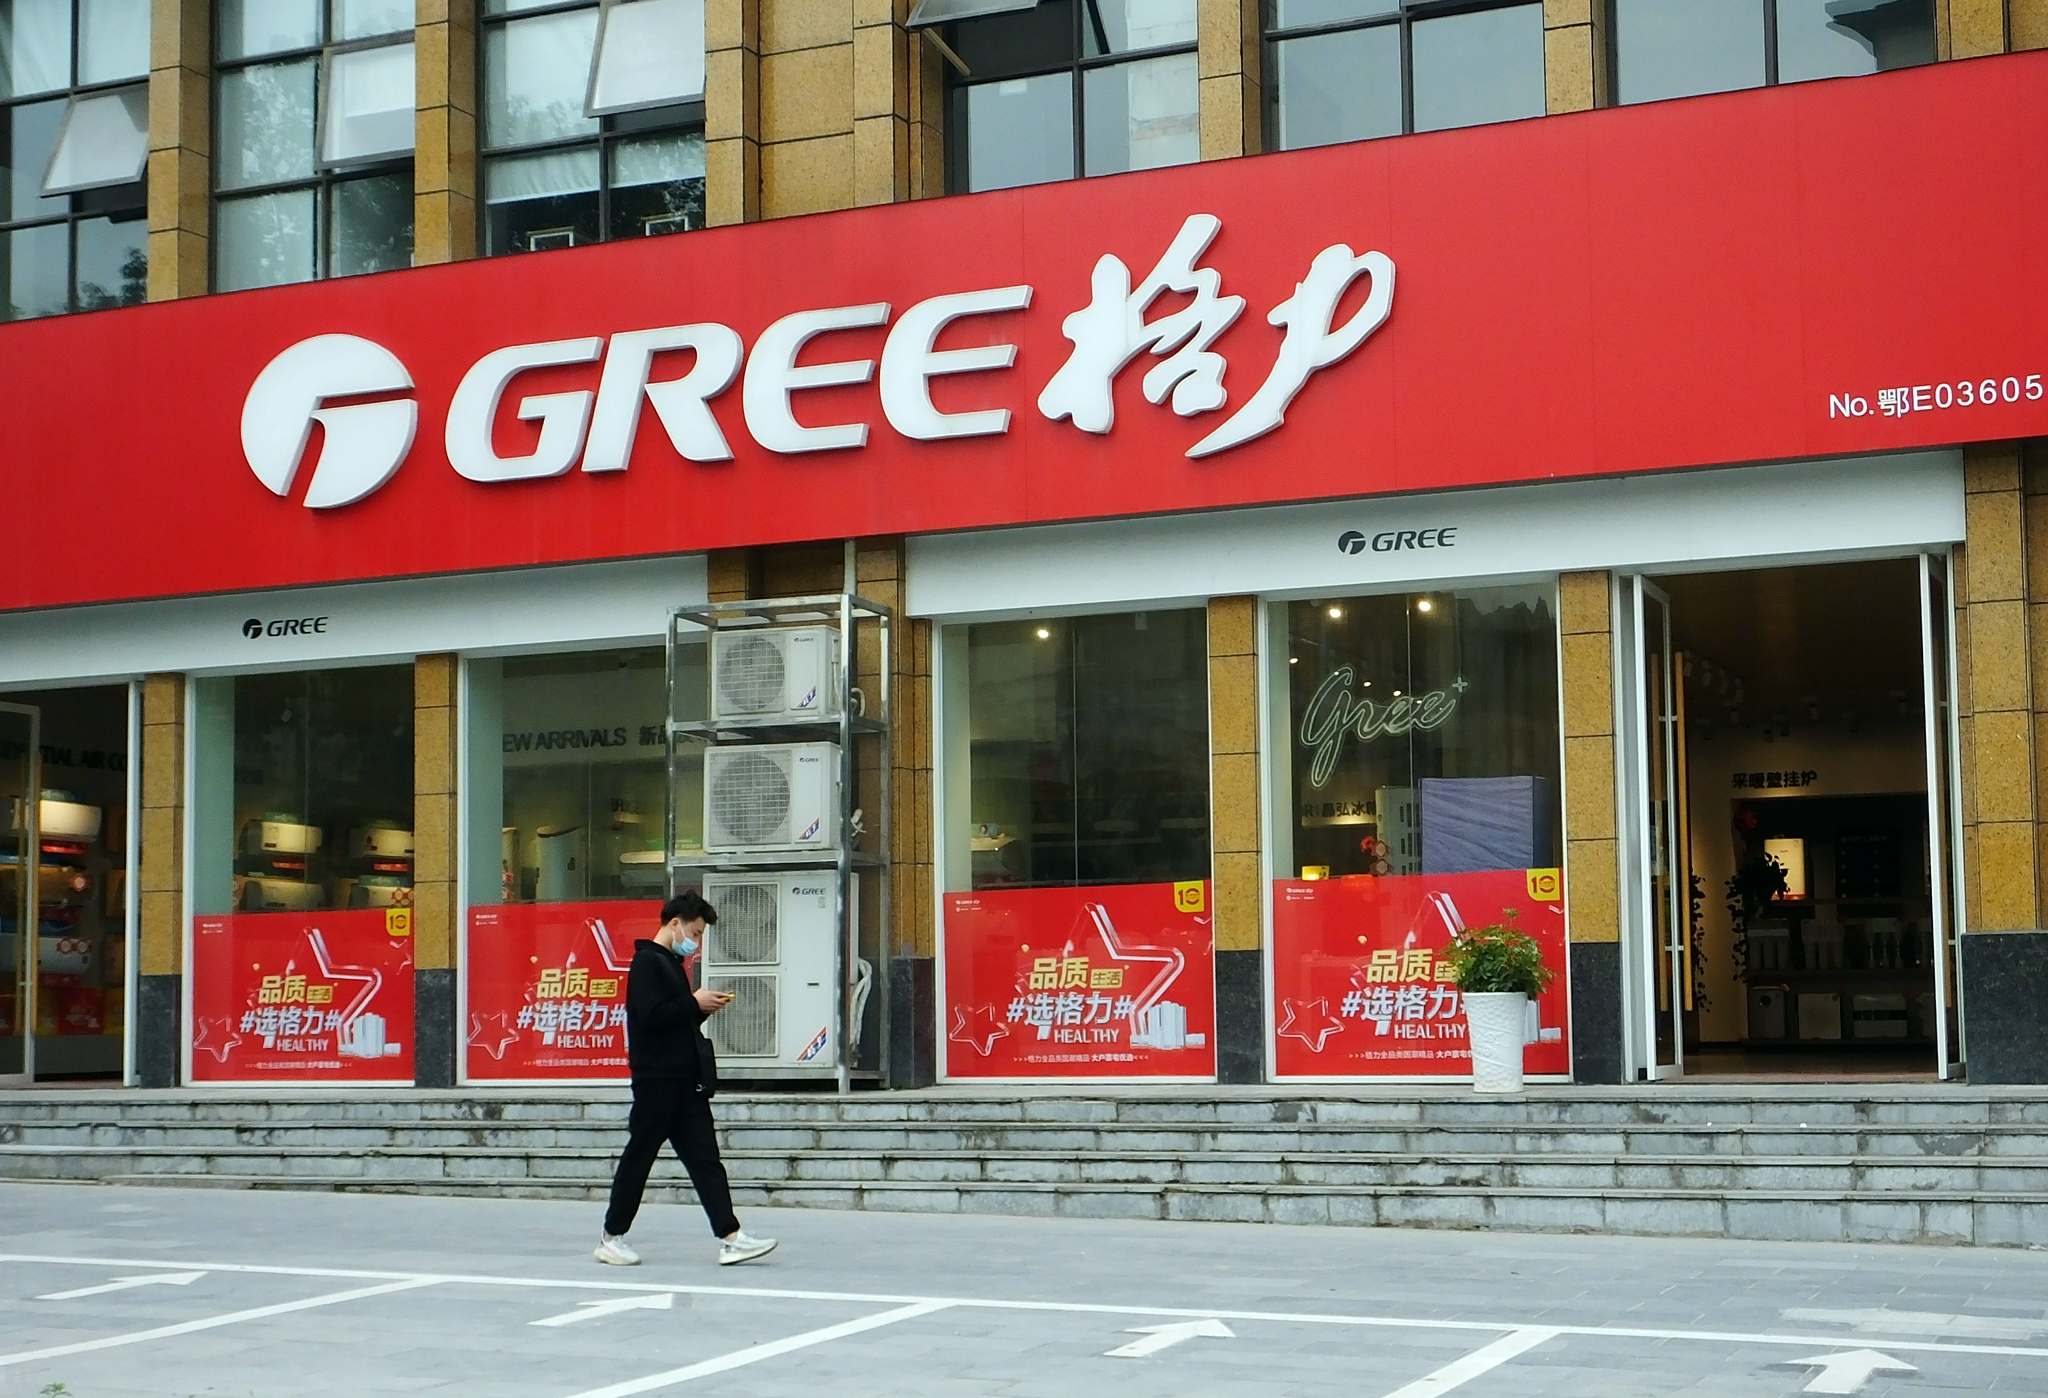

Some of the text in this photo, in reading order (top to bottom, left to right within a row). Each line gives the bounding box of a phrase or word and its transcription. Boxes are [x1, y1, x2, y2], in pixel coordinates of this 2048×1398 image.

[444, 284, 1033, 483] GREE
[1371, 527, 1458, 552] GREE
[266, 616, 329, 637] GREE
[502, 733, 533, 753] EW
[534, 727, 628, 751] ARRIVALS
[1732, 769, 1818, 789] 采暖壁挂炉
[801, 888, 827, 896] GREE
[1028, 956, 1122, 990] 品质 生活
[1365, 948, 1434, 983] 品质
[258, 974, 307, 1004] 品质
[536, 967, 617, 999] 品质 生活
[516, 999, 627, 1045] #选格力#
[1006, 991, 1134, 1041] #选格力#
[1340, 984, 1468, 1037] #选格力
[239, 1005, 342, 1049] #选格力#
[1053, 1027, 1120, 1044] HEALTHY
[1393, 1022, 1468, 1040] HEALTHY
[276, 1038, 330, 1052] HEALTHY
[557, 1034, 615, 1049] HEALTHY
